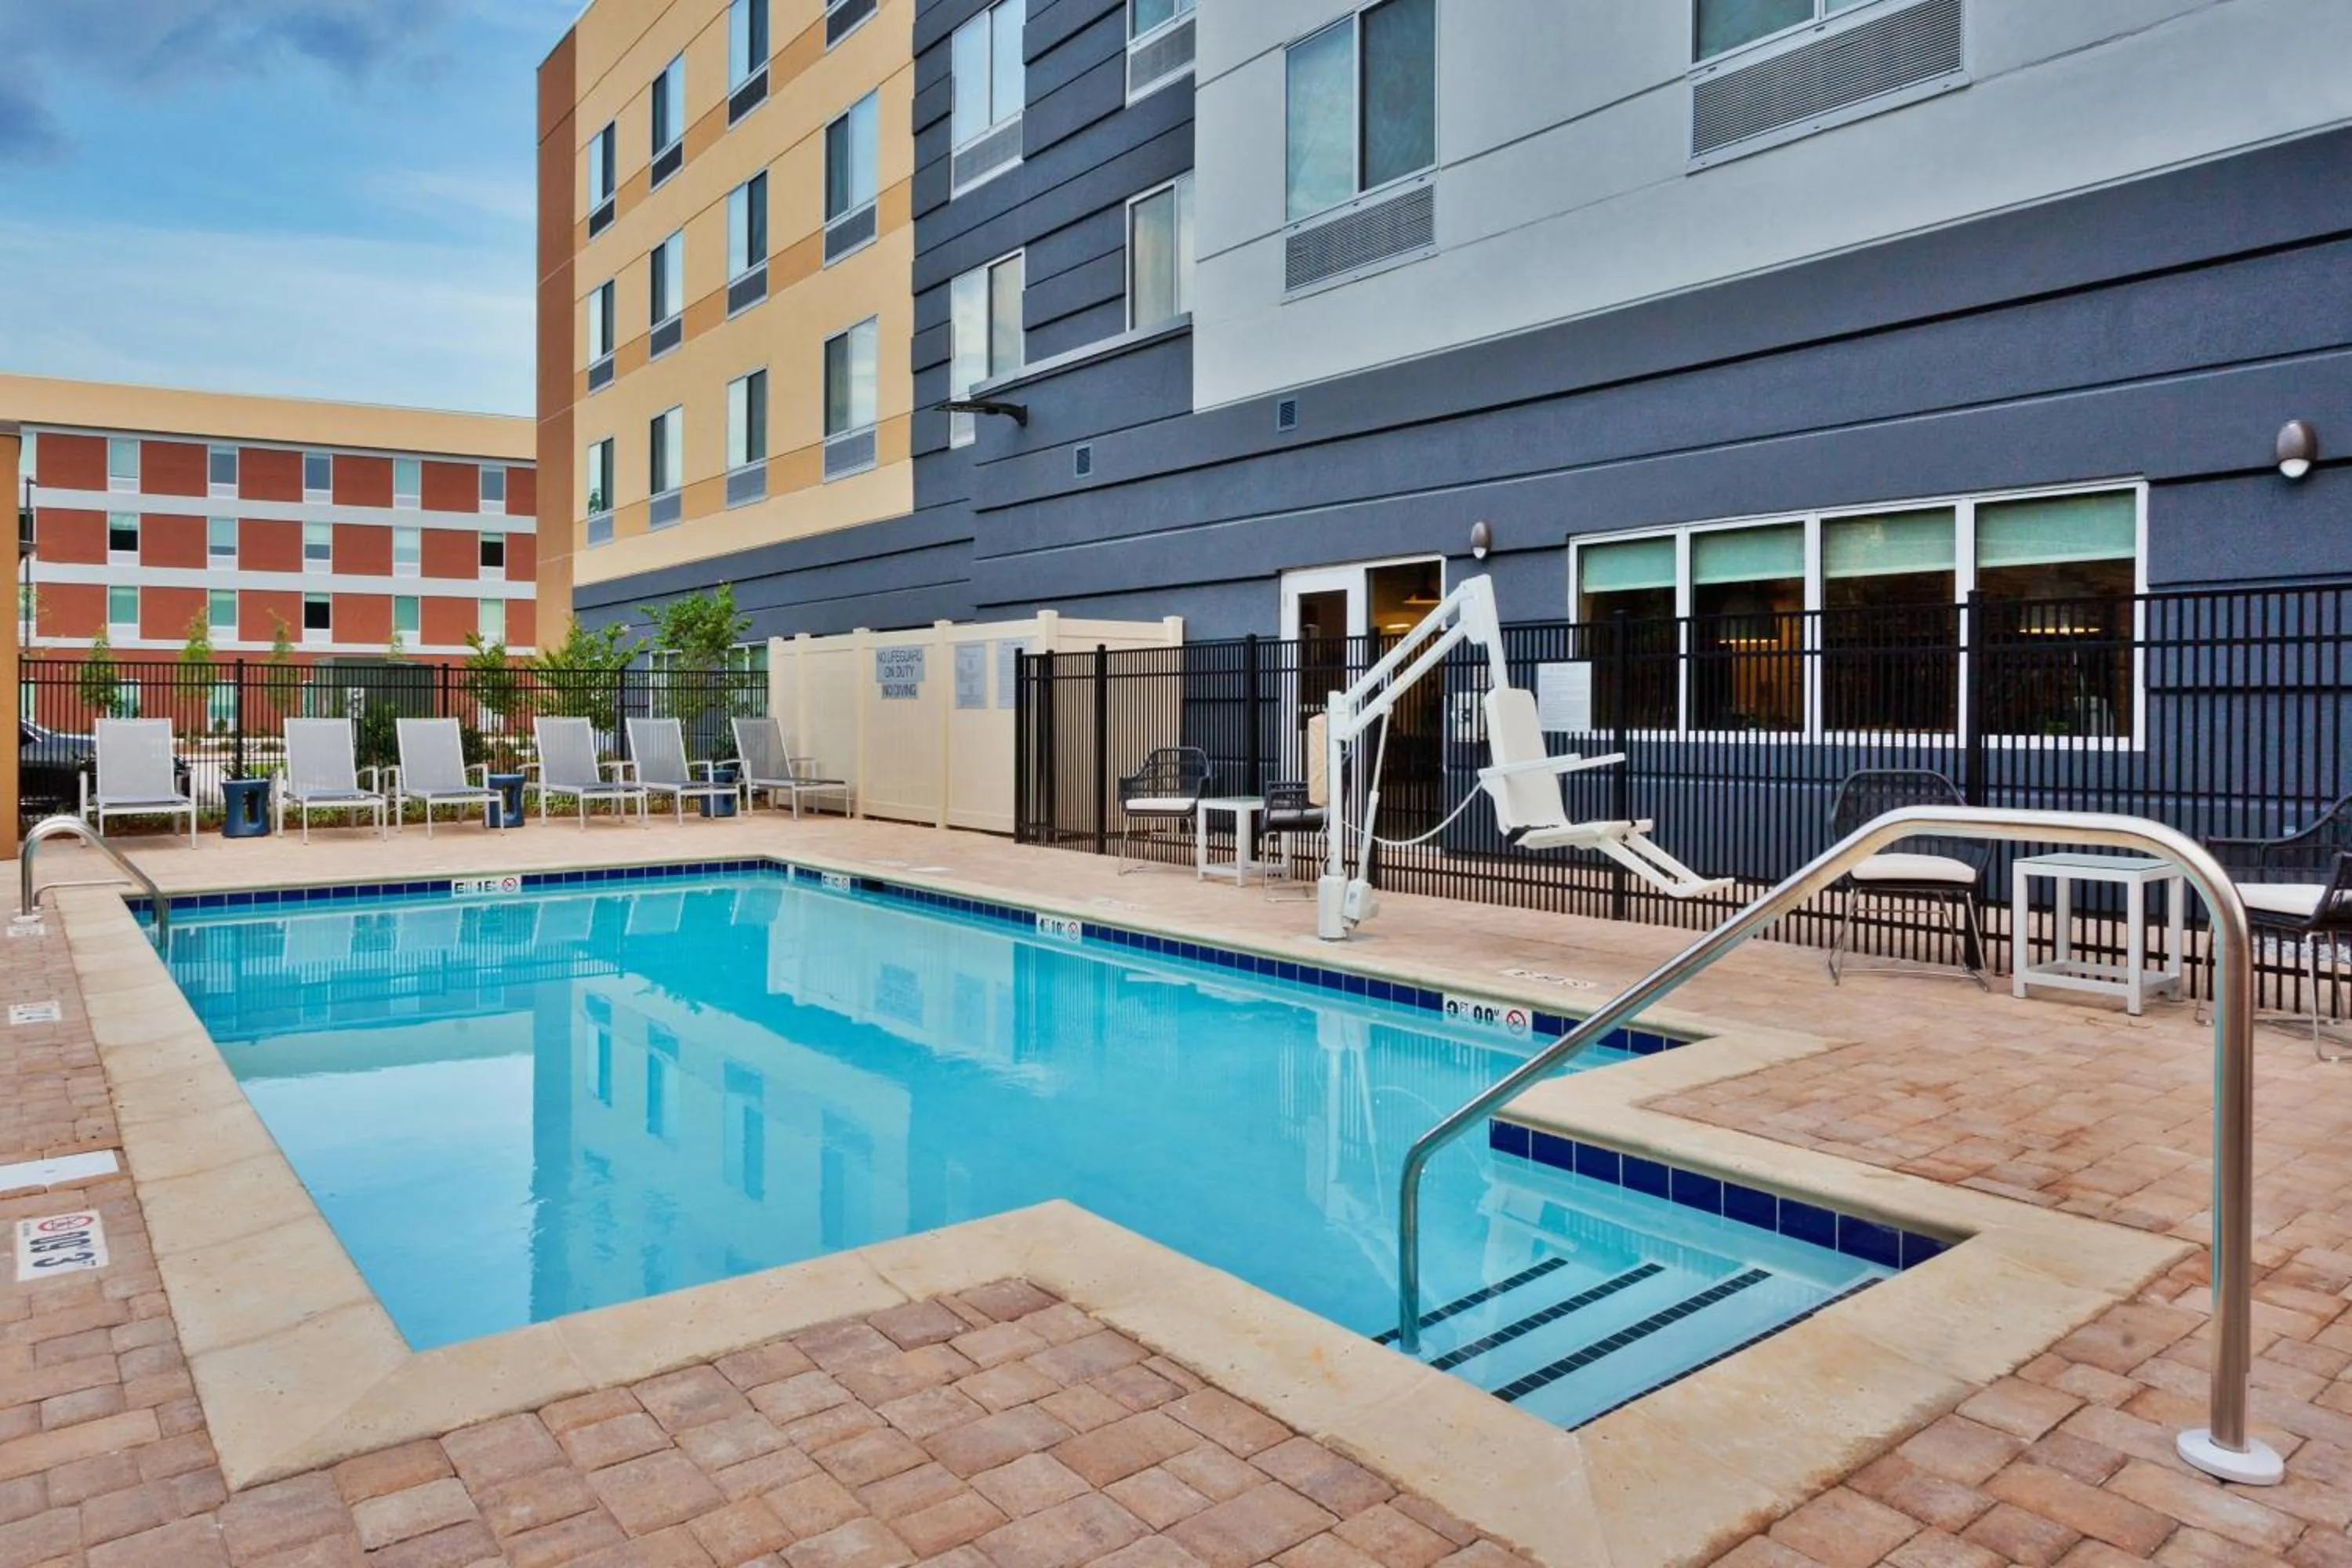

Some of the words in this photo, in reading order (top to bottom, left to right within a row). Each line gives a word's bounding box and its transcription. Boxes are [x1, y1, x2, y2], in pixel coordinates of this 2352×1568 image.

[878, 651, 887, 664] NO
[884, 666, 895, 678] ON
[896, 665, 915, 678] DUTY
